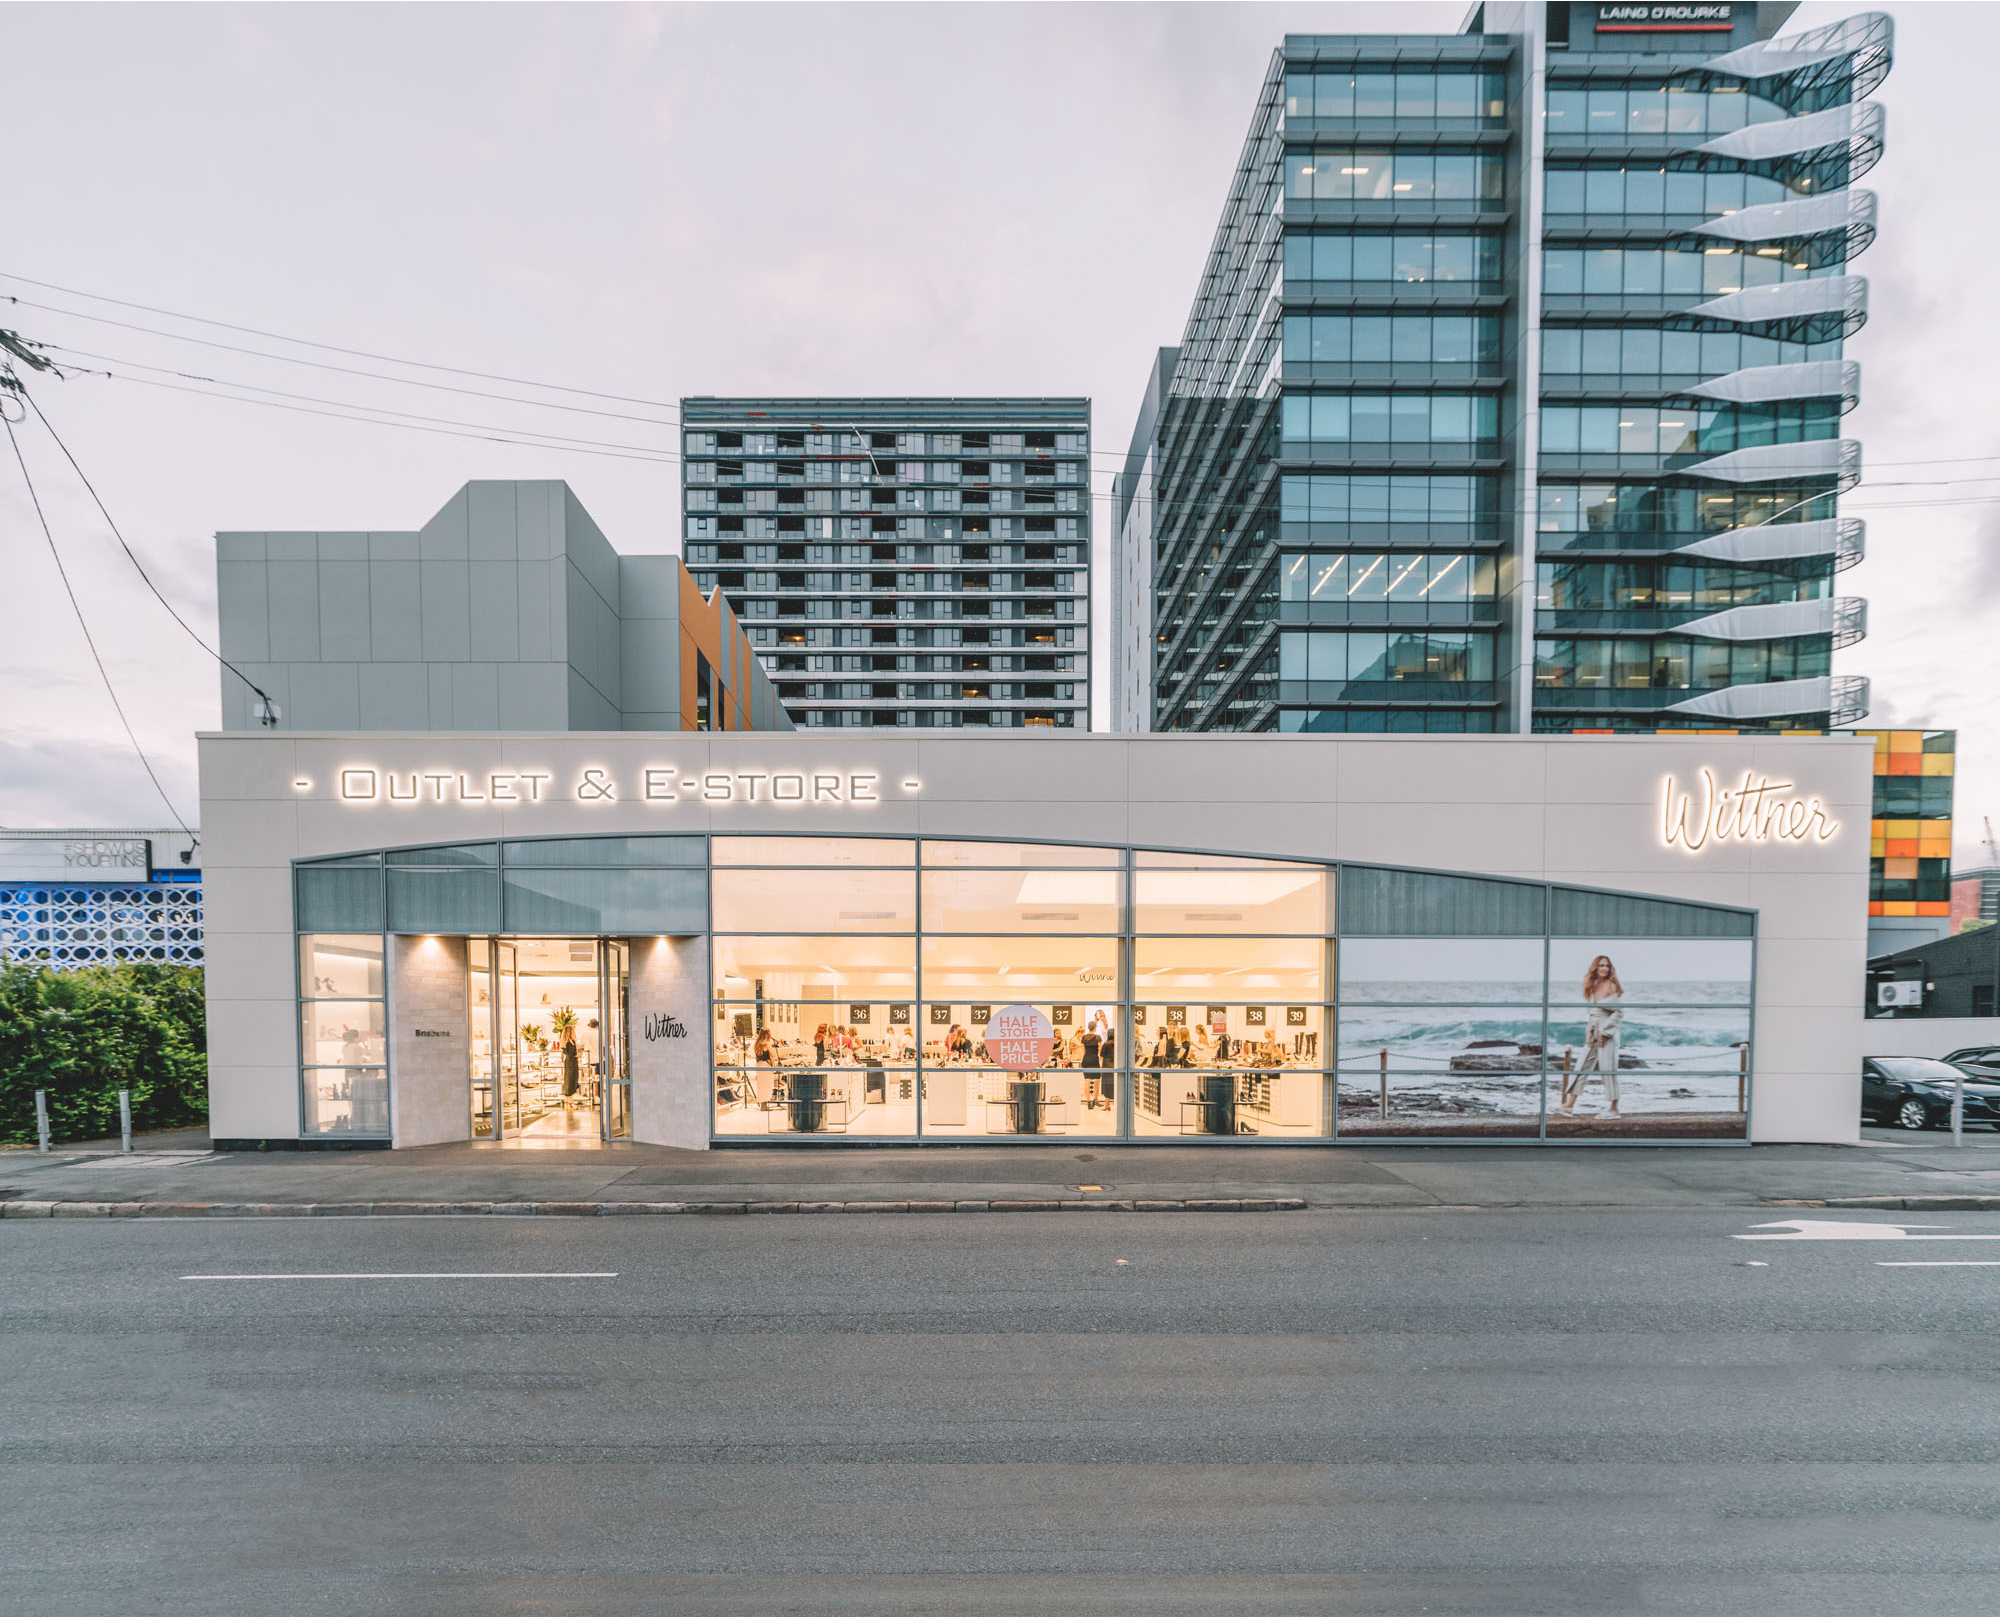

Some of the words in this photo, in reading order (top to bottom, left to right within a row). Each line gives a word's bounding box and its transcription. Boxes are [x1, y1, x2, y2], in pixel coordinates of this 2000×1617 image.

[1600, 6, 1649, 19] LAING
[1651, 5, 1731, 19] O'ROURKE
[577, 770, 615, 800] &
[1665, 770, 1839, 850] Wittner
[854, 1009, 867, 1020] 36
[893, 1009, 906, 1020] 36
[934, 1010, 948, 1020] 37
[974, 1010, 988, 1020] 37
[1055, 1010, 1069, 1021] 37
[1169, 1010, 1183, 1020] 38
[1249, 1010, 1263, 1021] 38
[1289, 1010, 1304, 1021] 39
[645, 1012, 688, 1042] Wittner
[1000, 1016, 1037, 1027] HALF
[1000, 1028, 1038, 1037] STORE
[1000, 1040, 1038, 1053] HALF
[1001, 1053, 1039, 1064] PRICE
